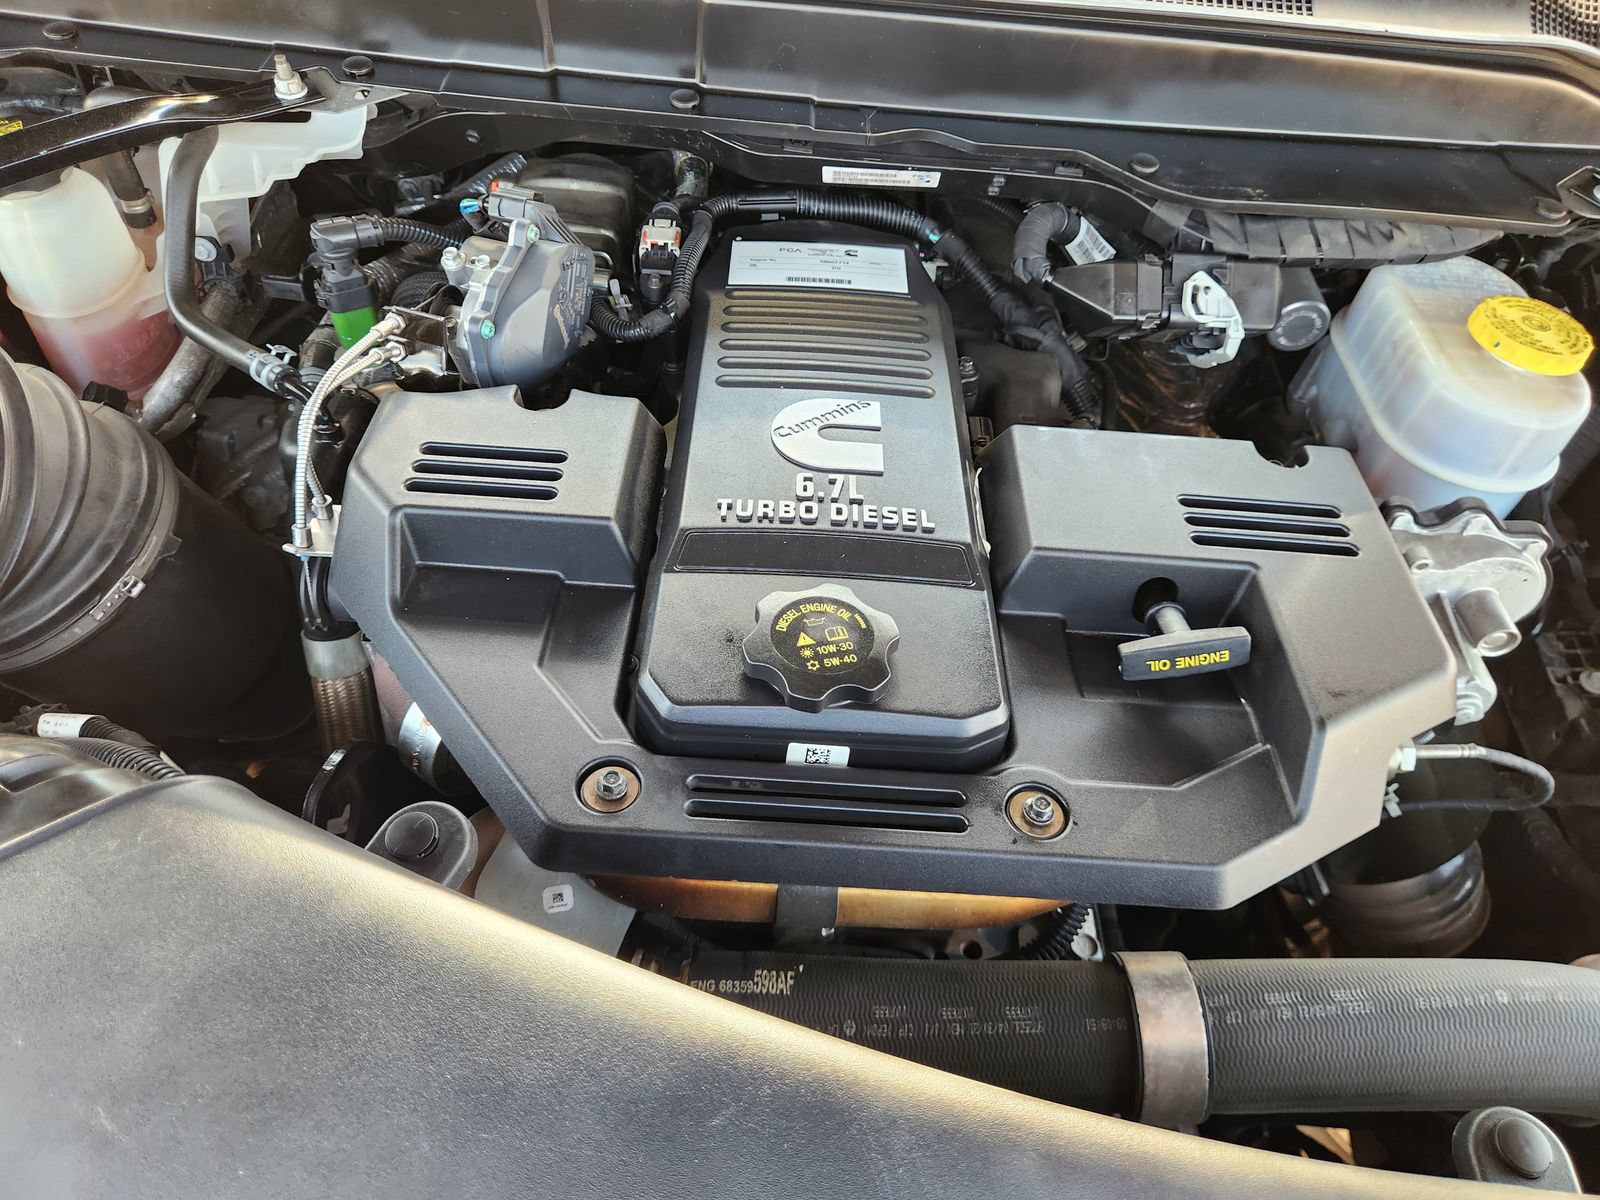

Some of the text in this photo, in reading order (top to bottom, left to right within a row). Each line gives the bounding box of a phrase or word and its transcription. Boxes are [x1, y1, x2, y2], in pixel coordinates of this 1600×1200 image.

[773, 400, 871, 438] Cummins
[795, 473, 864, 504] 6.7L
[717, 498, 936, 533] TURBO DIESEL
[775, 603, 852, 632] DIESEL ENGINE OIL
[816, 641, 854, 655] 10W-30
[823, 654, 858, 668] 5W-40
[1145, 649, 1230, 672] ENGINE OIL
